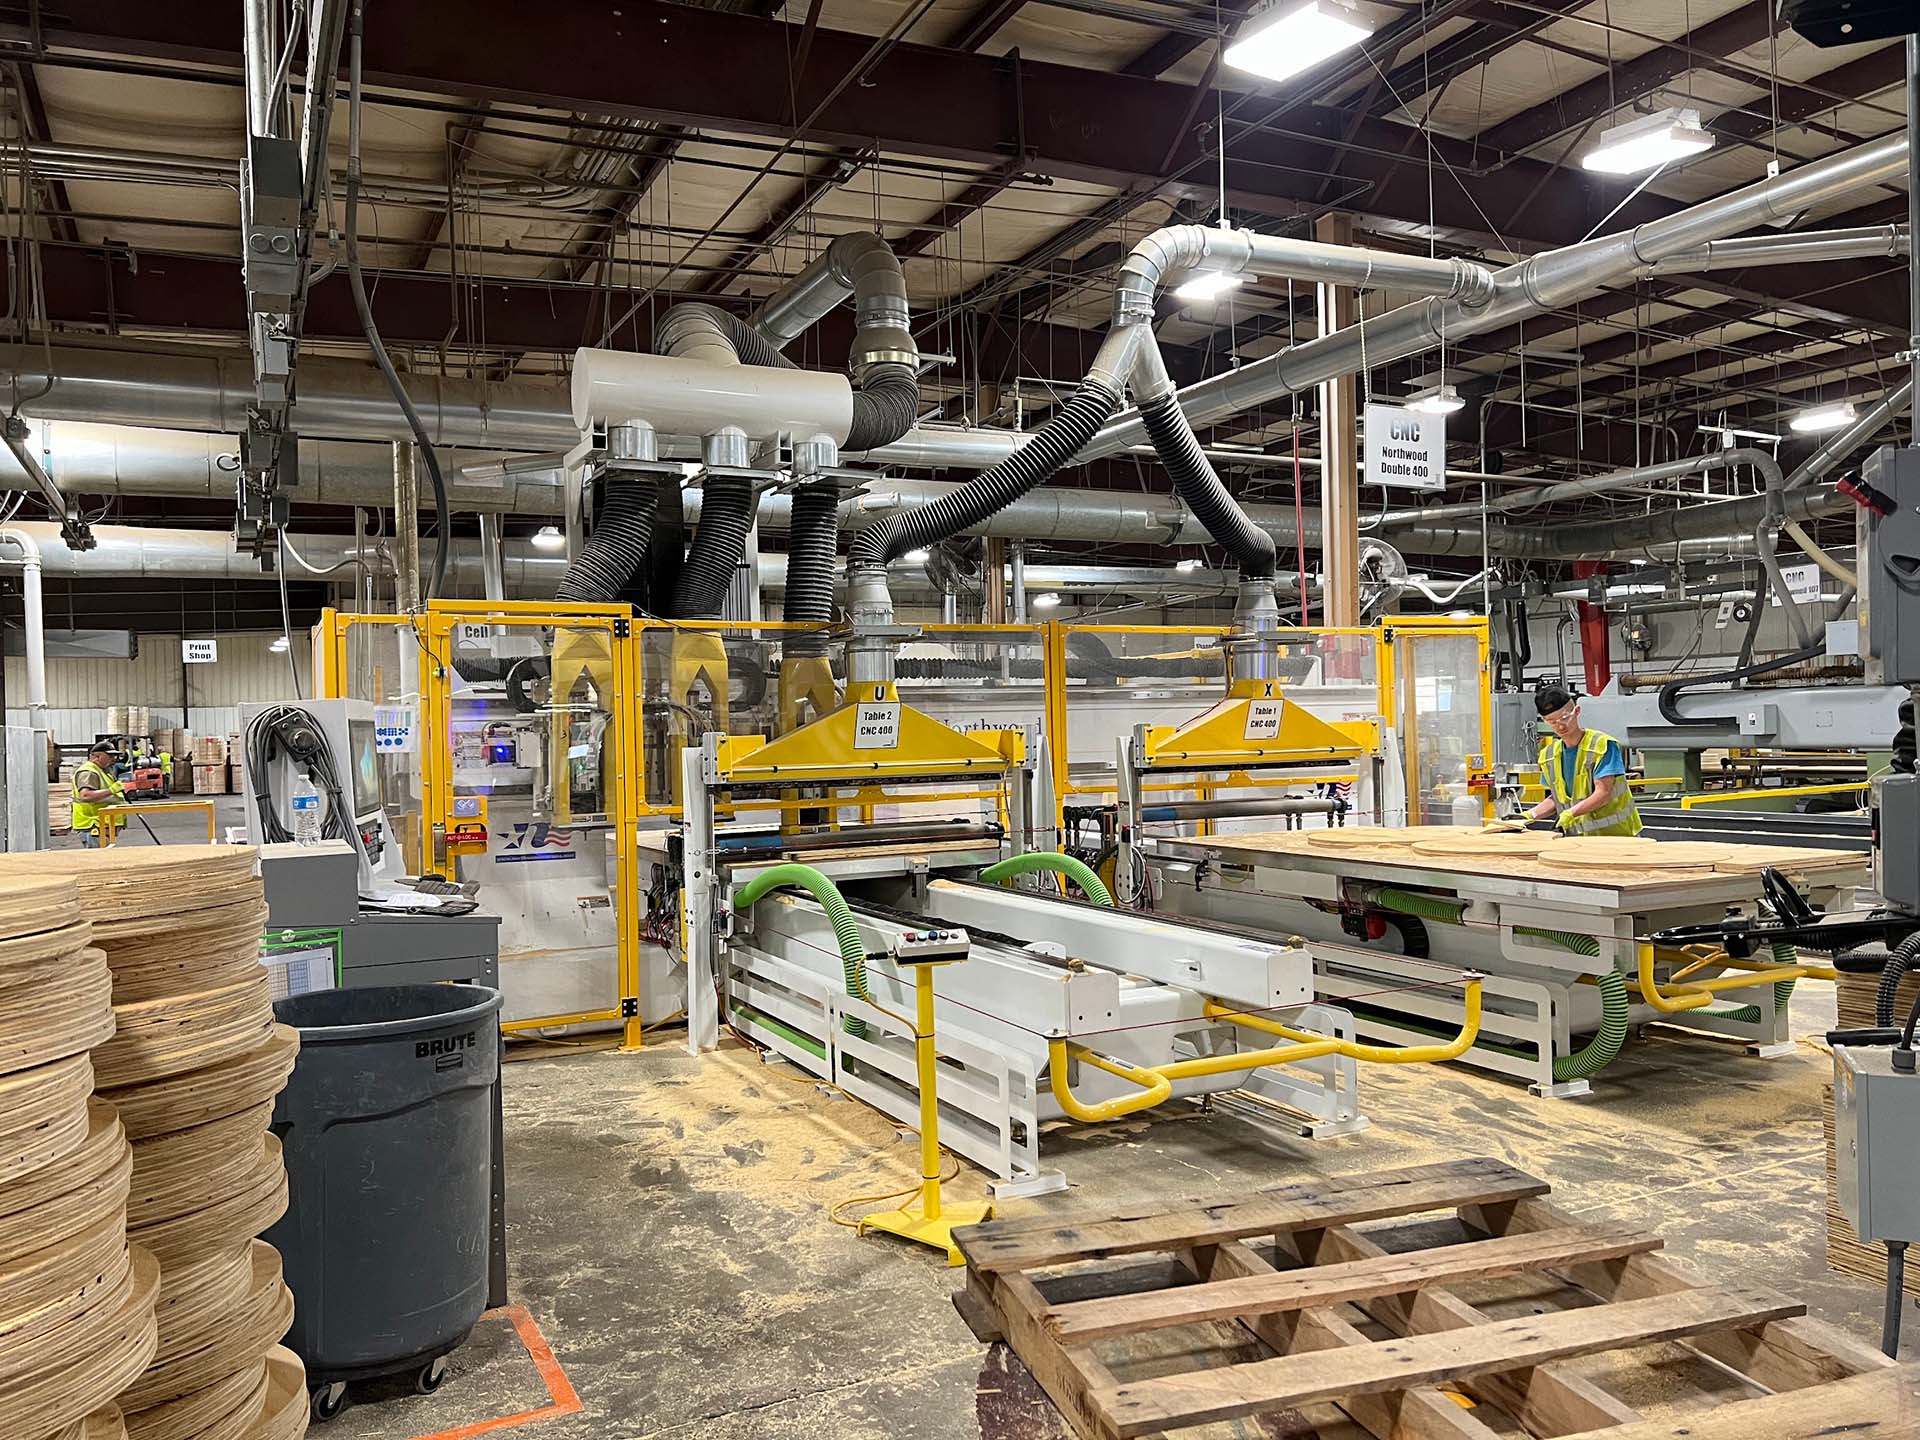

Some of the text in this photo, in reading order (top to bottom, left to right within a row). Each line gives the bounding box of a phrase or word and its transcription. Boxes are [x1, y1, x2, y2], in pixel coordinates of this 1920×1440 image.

[1390, 420, 1420, 442] CNC
[1382, 446, 1428, 462] Northwood
[1381, 462, 1429, 478] Double 400
[1785, 571, 1805, 583] CNC
[464, 625, 489, 638] Cell
[874, 685, 885, 701] U
[1264, 683, 1273, 697] X
[864, 710, 893, 721] Table 2
[1255, 707, 1277, 715] Table 1
[1250, 719, 1277, 728] CNC 400
[860, 725, 893, 736] CNC 400
[415, 1031, 477, 1059] BRUTE
